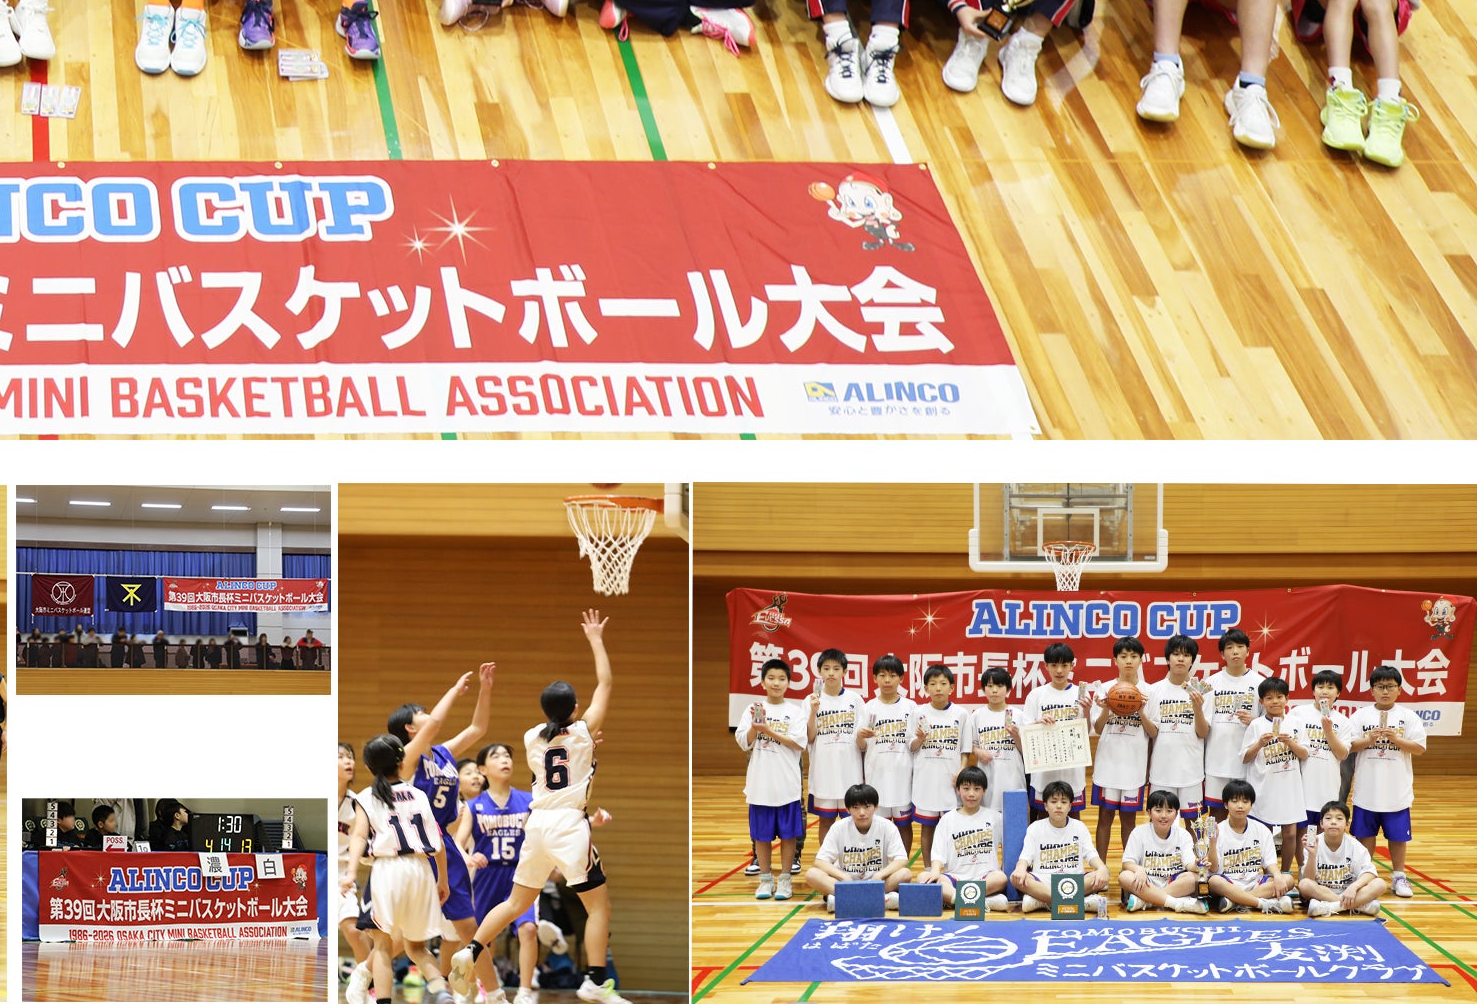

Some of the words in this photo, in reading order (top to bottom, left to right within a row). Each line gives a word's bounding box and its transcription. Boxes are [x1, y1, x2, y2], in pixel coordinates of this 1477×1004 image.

[173, 175, 395, 244] CUP
[111, 373, 428, 420] BASKETBALL
[446, 373, 765, 419] ASSOCIATION
[843, 381, 960, 403] ALINCO
[215, 581, 254, 590] ALINCO
[256, 581, 277, 590] CUP
[966, 599, 1141, 638] ALINCO
[1147, 600, 1241, 639] CUP
[817, 712, 855, 728] CHAMPS
[543, 745, 571, 792] 6
[433, 786, 449, 808] 5
[218, 815, 242, 833] 1:30
[388, 811, 436, 857] 11
[487, 829, 521, 837] EAGLES
[220, 838, 231, 851] 14
[241, 838, 252, 853] 13
[491, 837, 515, 860] 15
[954, 831, 992, 851] CHAMPS
[843, 848, 881, 864] CHAMPS
[1040, 845, 1079, 862] CHAMPS
[1144, 853, 1182, 868] CHAMPS
[1222, 847, 1261, 867] CHAMPS
[207, 856, 223, 873] 濃
[263, 859, 277, 876] 白
[108, 866, 201, 894] ALINCO
[50, 897, 308, 921] 第39回大阪市長杯ミニバスケットボール大会
[69, 928, 113, 941] 1986-2026
[117, 928, 144, 941] OSAKA
[147, 929, 165, 940] CITY
[168, 928, 185, 939] MINI
[188, 927, 236, 939] BASKETBALL
[239, 926, 287, 938] ASSOCIATION
[1026, 927, 1316, 959] EAGLES
[1032, 925, 1242, 942] TOMOBUCHI
[1256, 941, 1386, 963] 友渕
[1036, 962, 1427, 982] ミニバスケットボールクラブ
